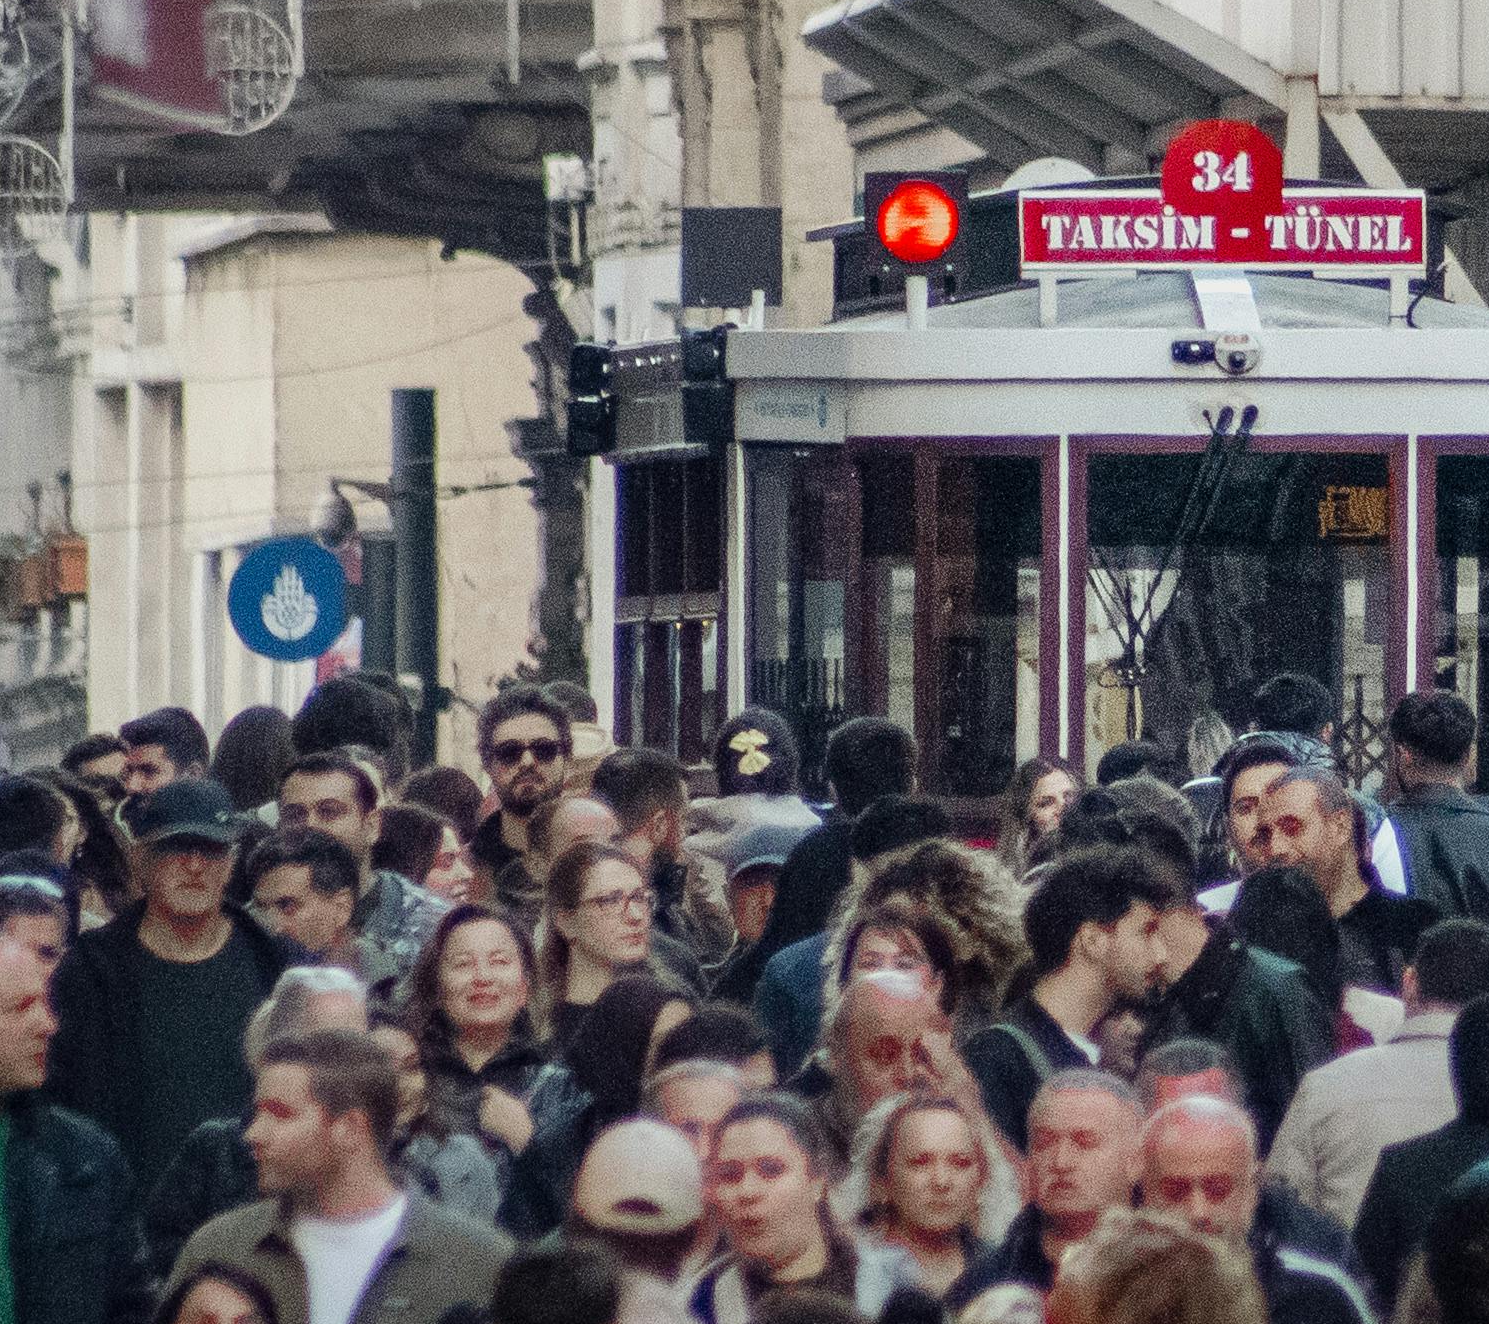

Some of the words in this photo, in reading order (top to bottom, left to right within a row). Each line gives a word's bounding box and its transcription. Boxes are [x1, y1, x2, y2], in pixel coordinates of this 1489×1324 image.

[1191, 151, 1252, 192] 34
[1042, 205, 1216, 251] TAKSİM
[1265, 206, 1411, 252] TÜNEL
